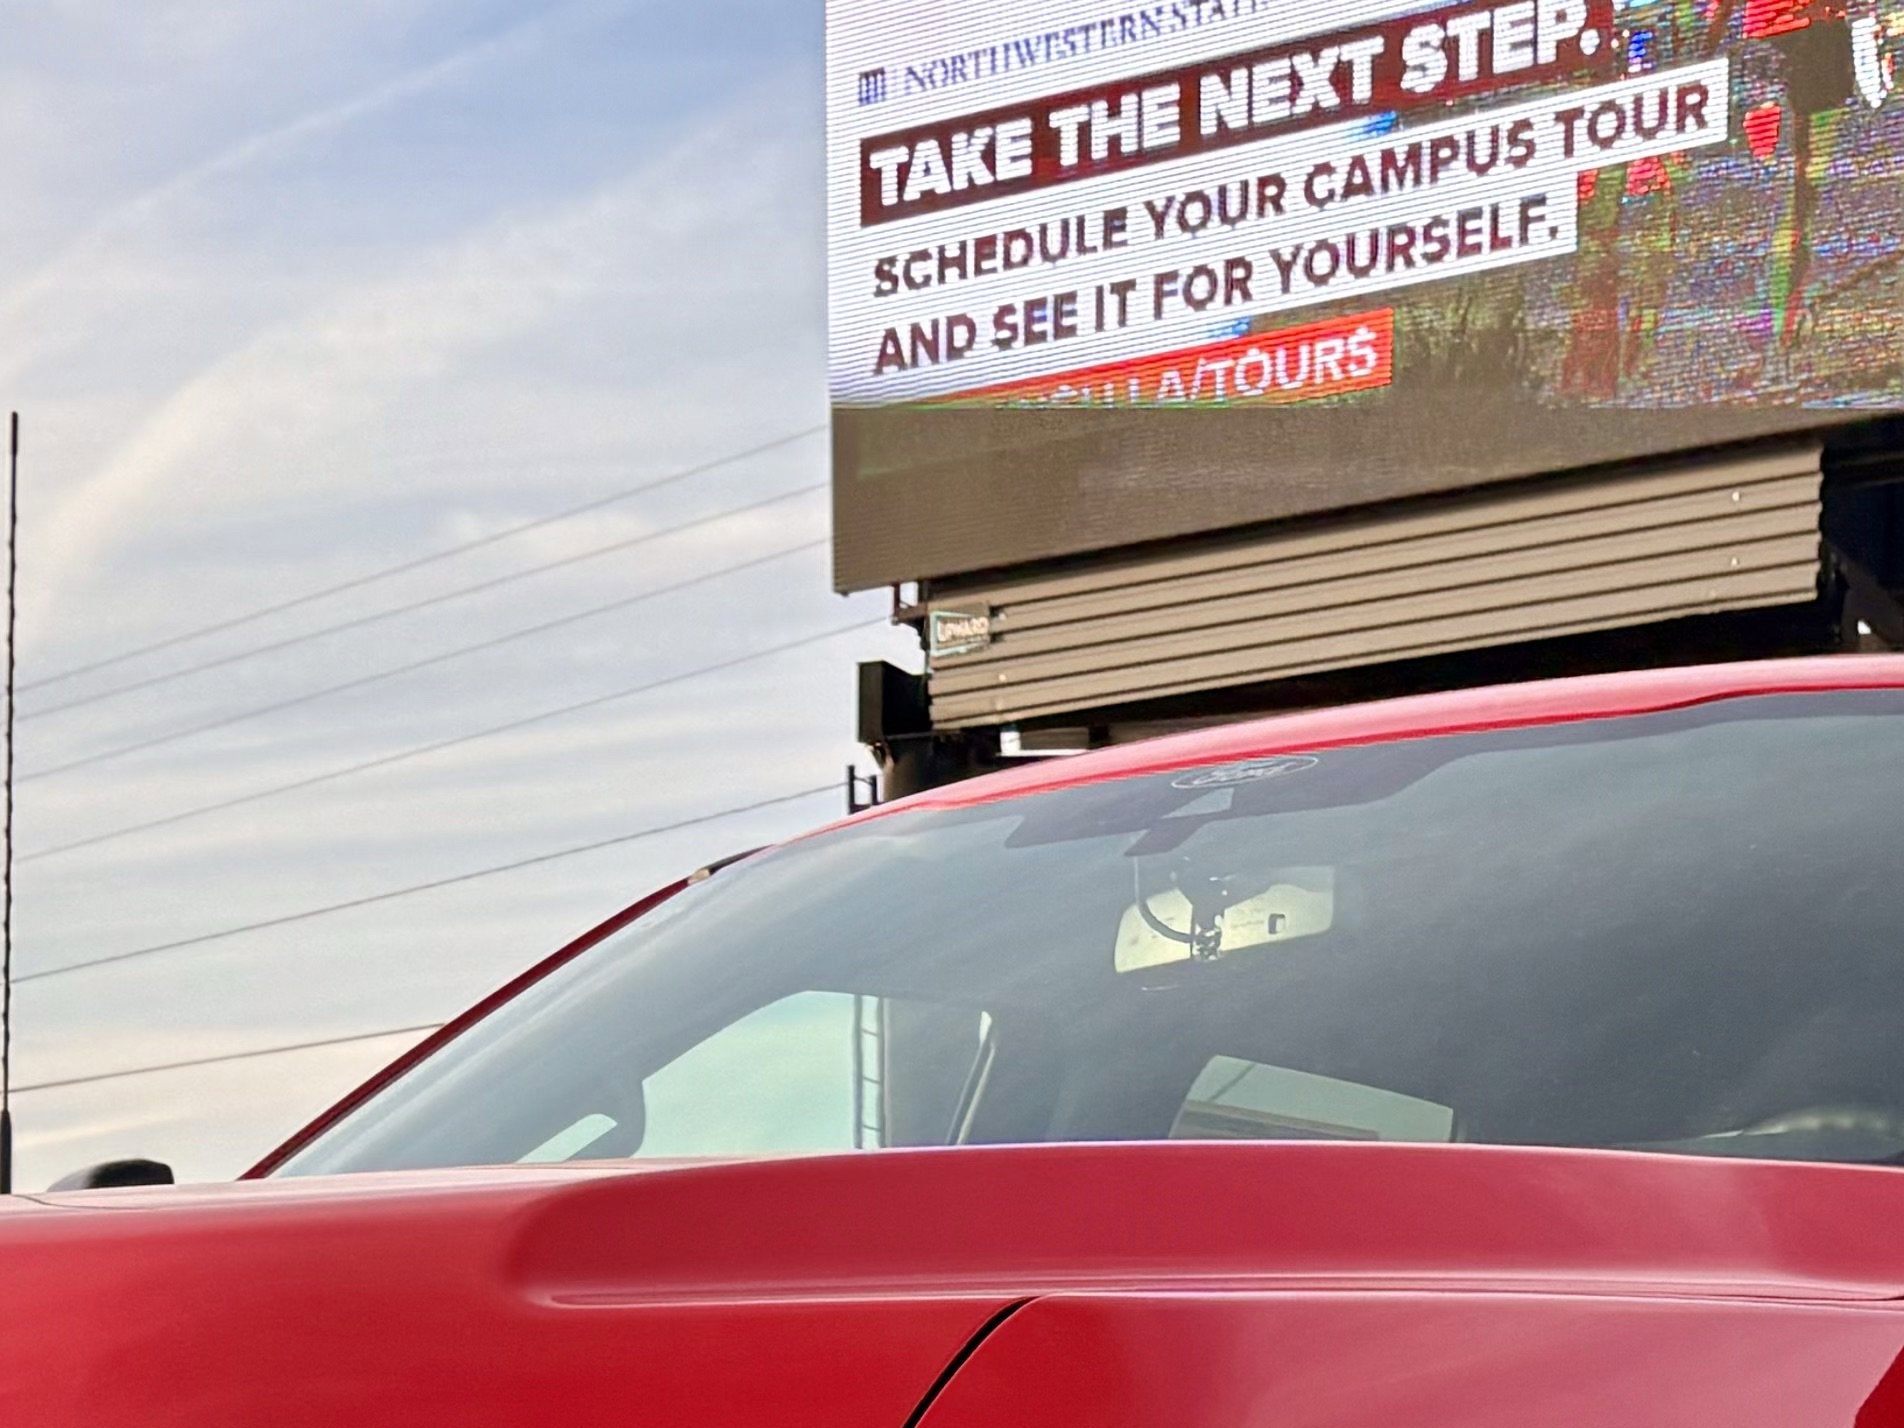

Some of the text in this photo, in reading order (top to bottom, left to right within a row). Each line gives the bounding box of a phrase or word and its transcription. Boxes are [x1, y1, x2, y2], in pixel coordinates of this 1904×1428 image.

[869, 0, 1599, 207] TAKE THE NEXT STEP.
[873, 83, 1711, 298] SCHEDULE YOUR CAMPUS TOUR
[872, 194, 1560, 377] AND SEE IT FOR YOURSELF.
